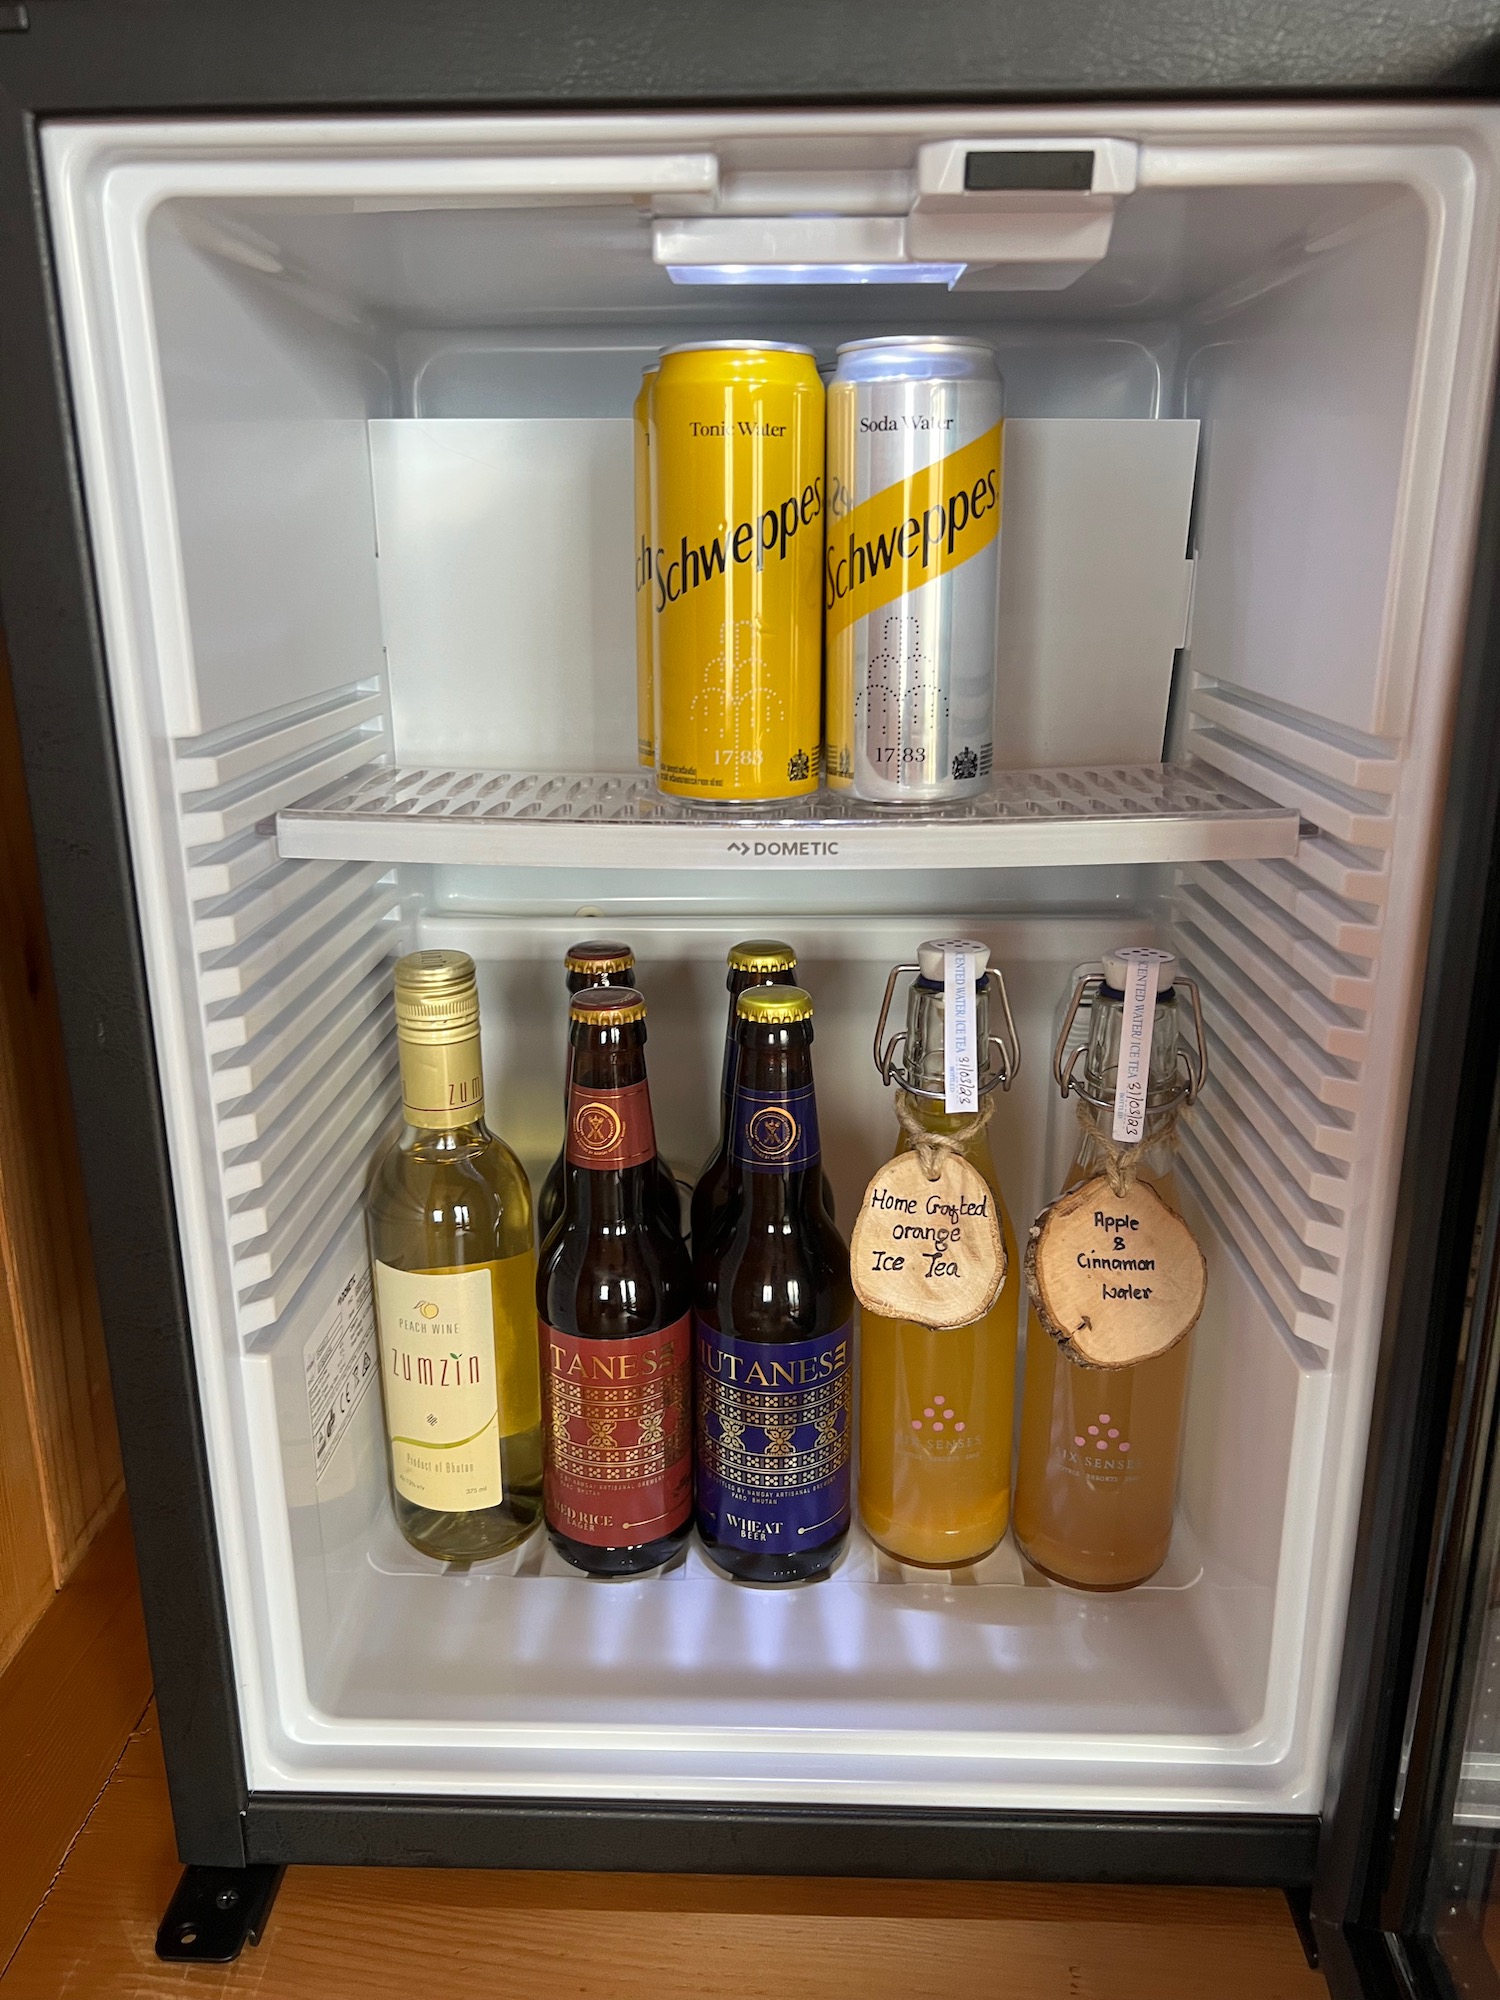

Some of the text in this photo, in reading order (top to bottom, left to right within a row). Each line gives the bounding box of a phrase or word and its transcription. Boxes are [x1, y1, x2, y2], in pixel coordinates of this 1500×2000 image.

[690, 421, 787, 437] Tonic Water
[859, 414, 954, 432] Soda Water
[655, 476, 821, 613] Schweppes
[826, 469, 996, 610] Schweppes
[754, 841, 839, 856] DOMETIC
[956, 1020, 967, 1035] ICE
[956, 1036, 968, 1053] TEA
[1129, 1041, 1142, 1057] ICE
[1127, 1058, 1139, 1079] TEA
[871, 1188, 917, 1214] Home
[1094, 1211, 1139, 1233] Apple
[871, 1251, 961, 1278] Ice Tea
[1077, 1249, 1155, 1271] Cinnamon
[398, 1318, 459, 1334] PEACH WINE
[407, 1453, 474, 1473] Product of Bhutan
[748, 1488, 773, 1498] NAMGAY
[776, 1488, 810, 1498] ARTISANAL
[752, 1497, 778, 1505] BHUTAN
[553, 1499, 614, 1527] RED RICE
[566, 1517, 596, 1531] LAGER
[726, 1512, 784, 1534] WHEAT
[740, 1529, 767, 1541] BEER
